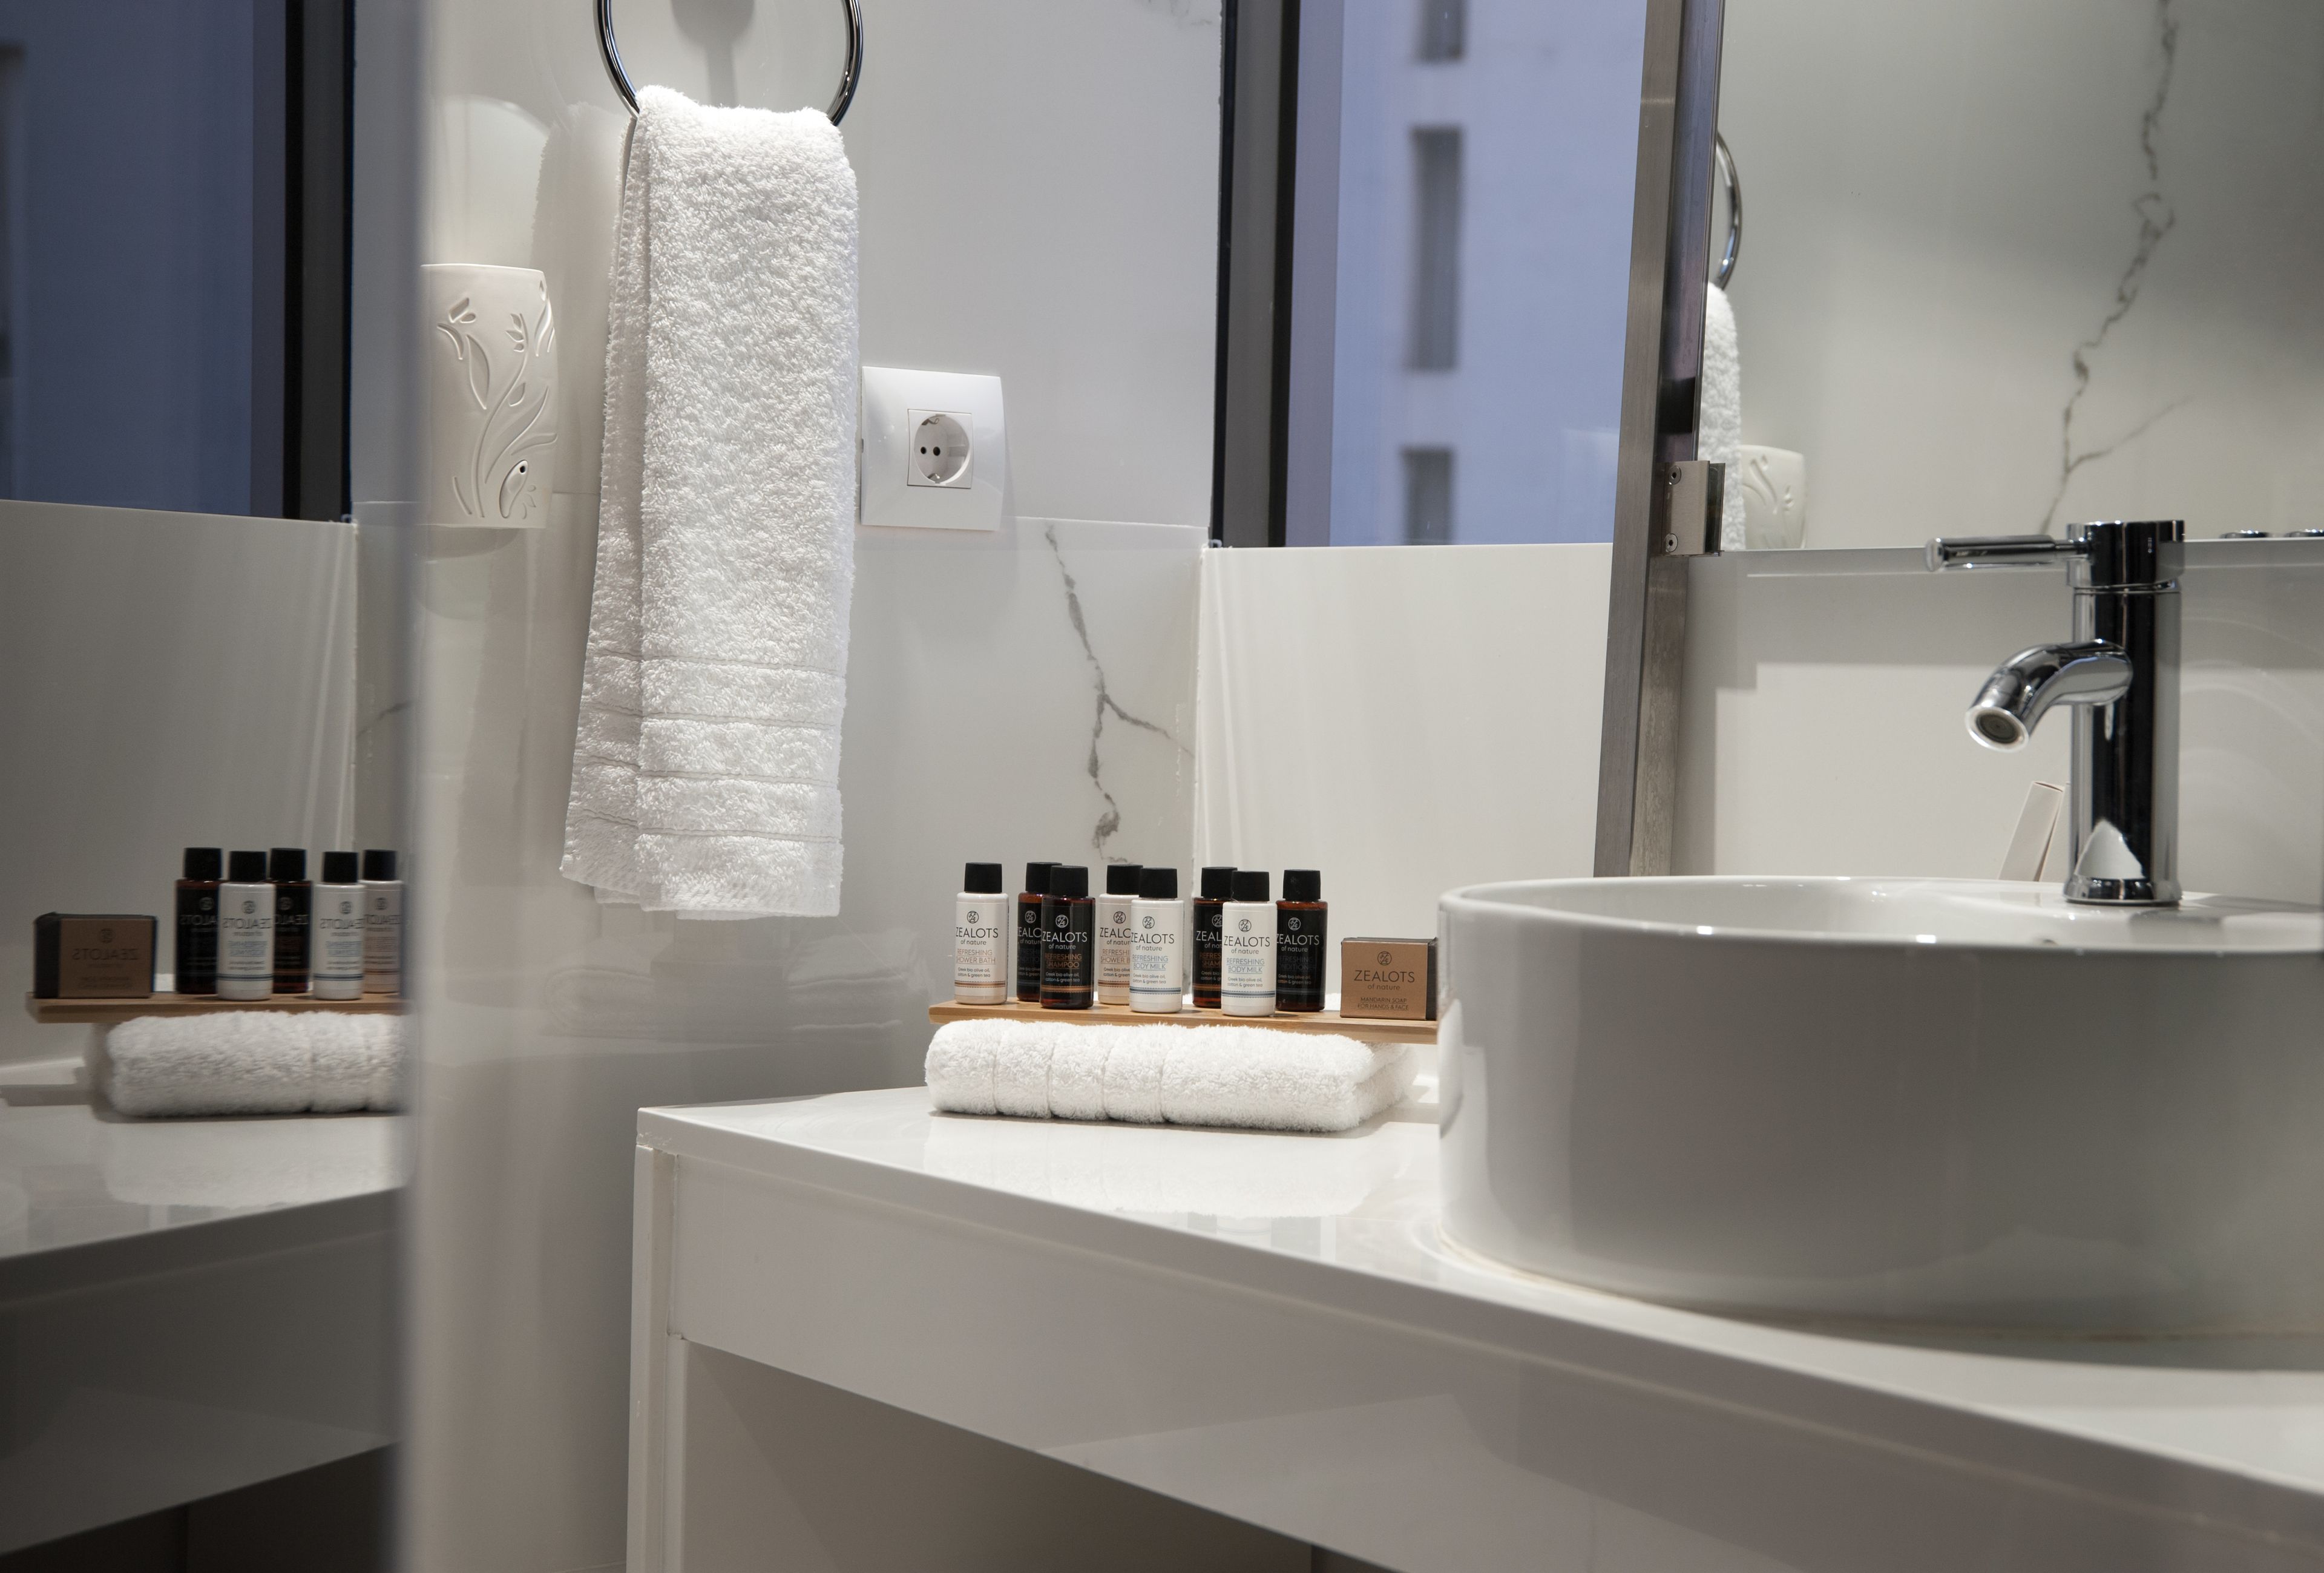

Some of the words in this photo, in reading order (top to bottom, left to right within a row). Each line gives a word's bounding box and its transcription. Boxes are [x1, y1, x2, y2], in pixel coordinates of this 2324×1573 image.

[956, 927, 999, 938] ZEALOTS
[1017, 927, 1042, 938] EALO
[1042, 931, 1088, 942] ZEALOTS
[1131, 932, 1175, 944] ZEALOTS
[1224, 936, 1270, 947] ZEALOTS
[1354, 970, 1415, 983] ZEALOTS
